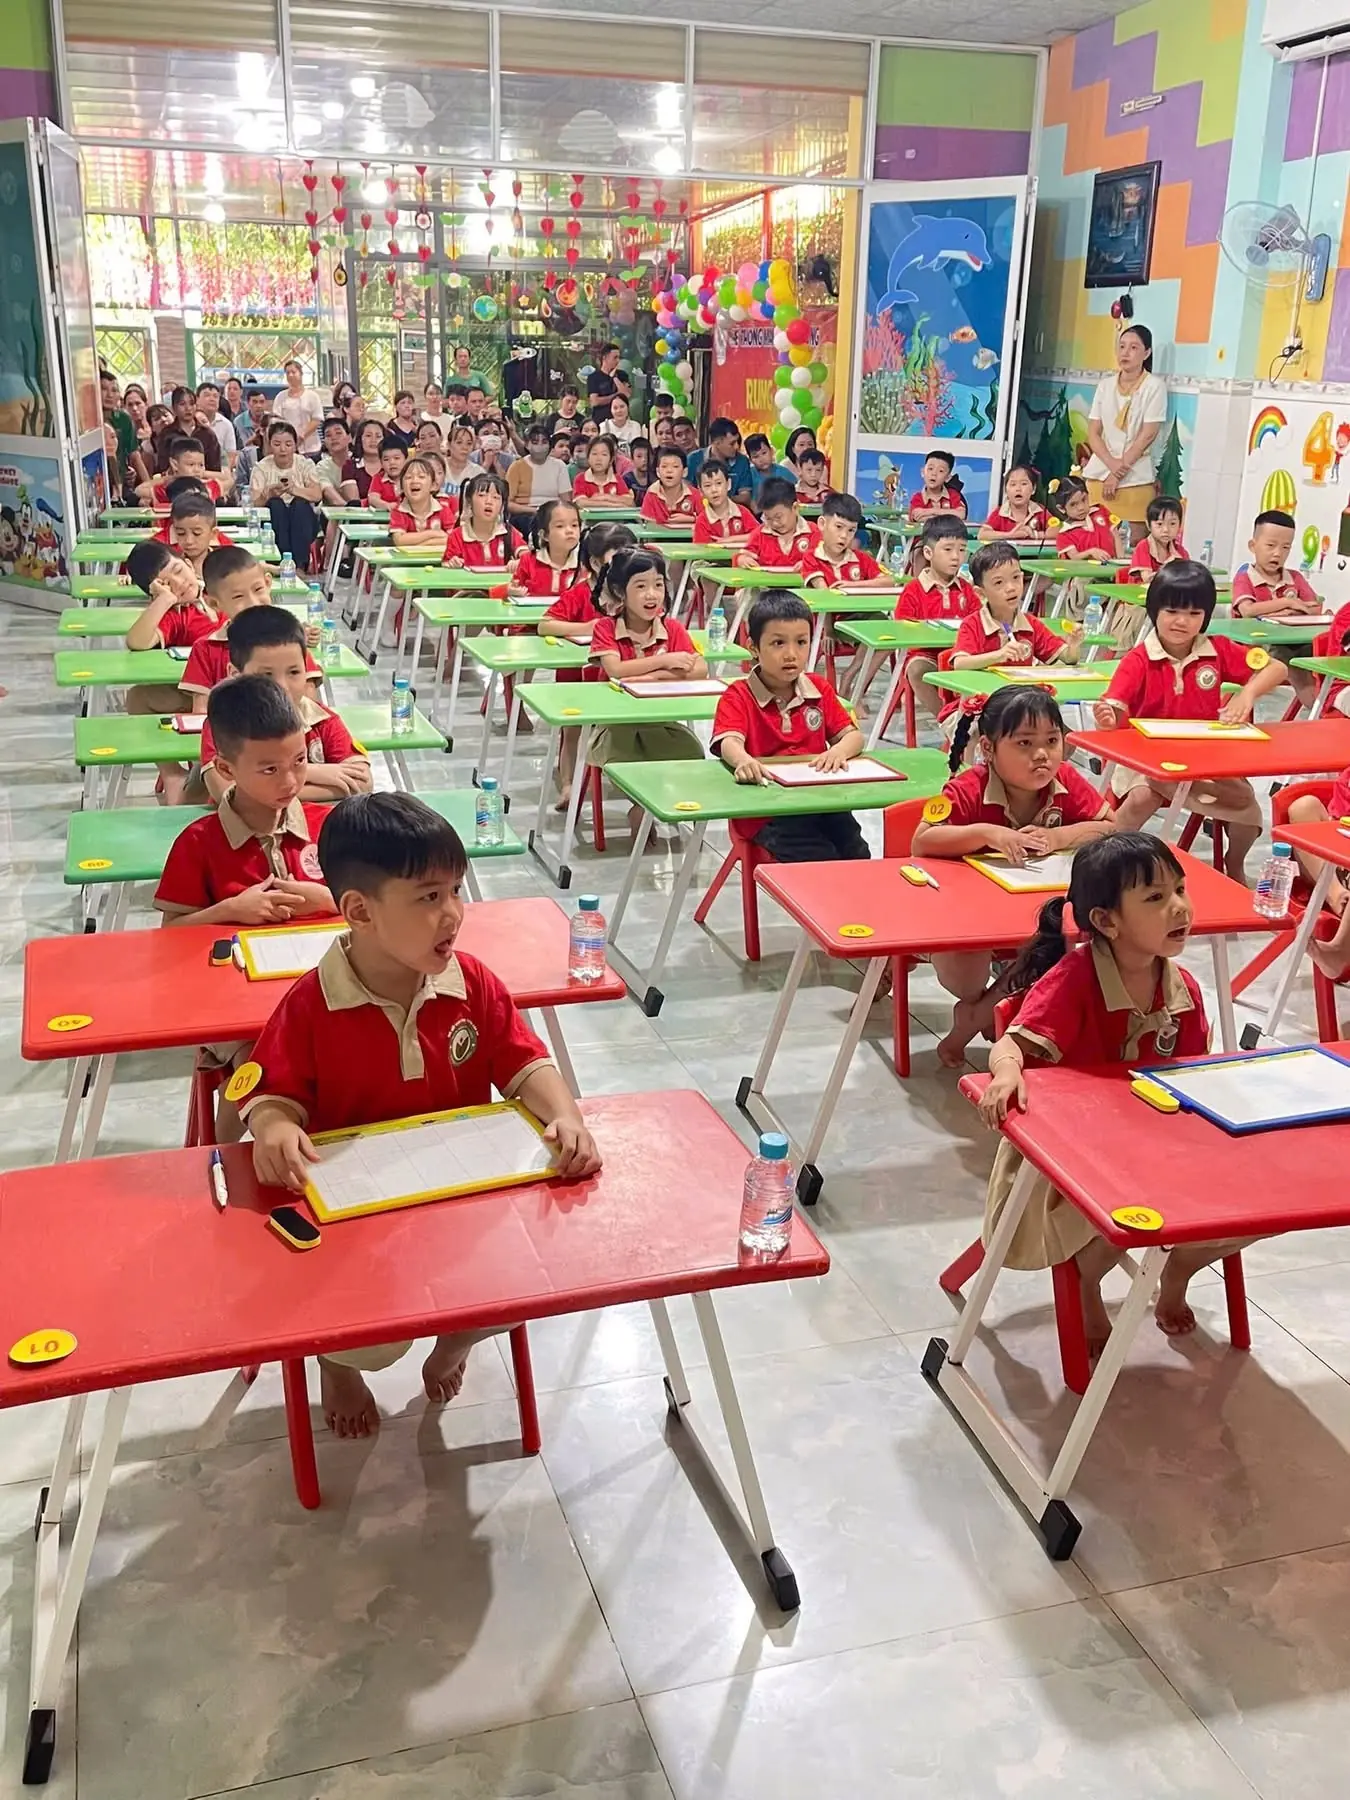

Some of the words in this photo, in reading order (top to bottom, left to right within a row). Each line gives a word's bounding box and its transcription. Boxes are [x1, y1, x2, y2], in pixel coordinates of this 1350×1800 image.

[1303, 411, 1334, 483] 4
[930, 803, 945, 815] 02
[234, 1073, 252, 1091] 01
[29, 1340, 60, 1355] 01
